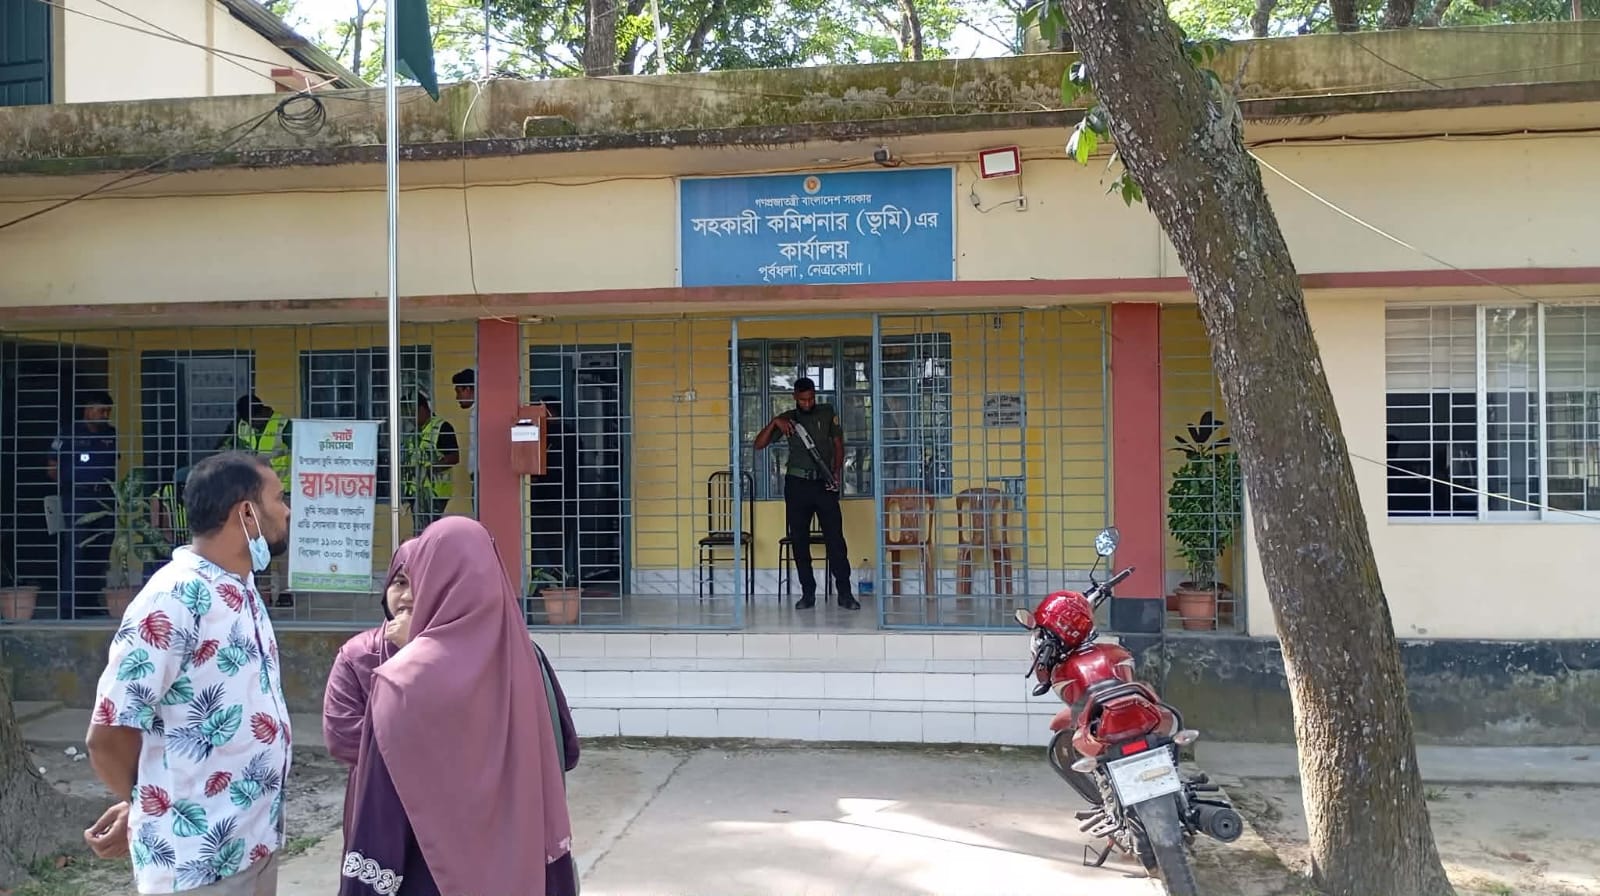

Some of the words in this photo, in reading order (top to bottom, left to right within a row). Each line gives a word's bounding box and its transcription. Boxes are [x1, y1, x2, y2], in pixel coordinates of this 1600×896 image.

[801, 194, 841, 207] বাংলাদেশ
[842, 193, 872, 205] সরকার
[690, 209, 761, 238] সহকারী
[765, 207, 850, 233] কমিশনার
[856, 204, 911, 236] (ভূমি)
[914, 211, 940, 228] এর
[777, 234, 850, 262] কার্যালয়
[298, 472, 376, 500] স্বাগতম
